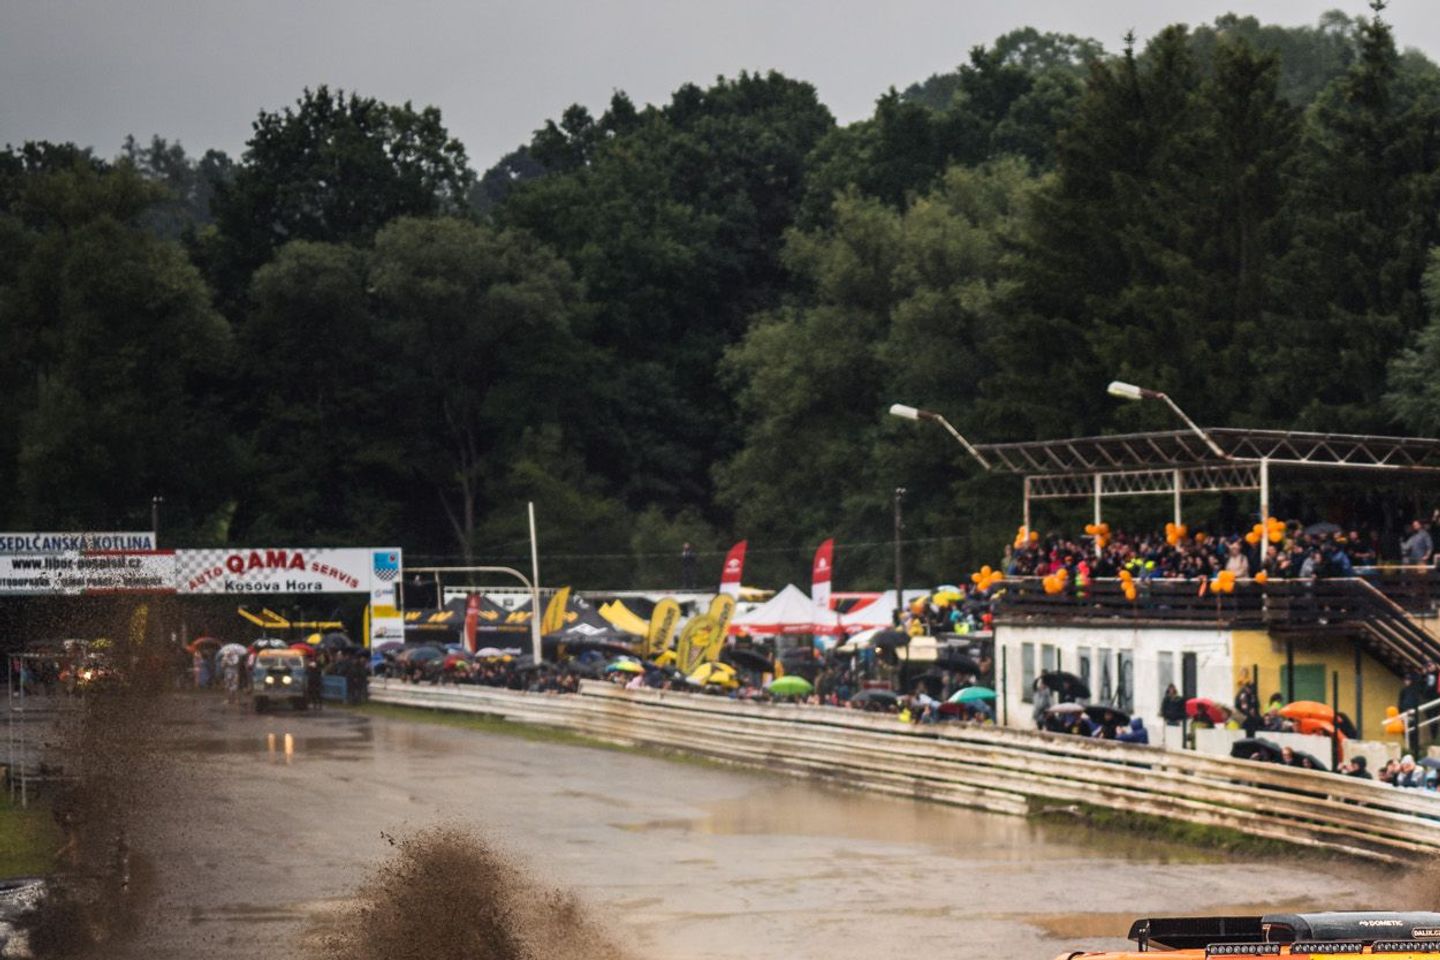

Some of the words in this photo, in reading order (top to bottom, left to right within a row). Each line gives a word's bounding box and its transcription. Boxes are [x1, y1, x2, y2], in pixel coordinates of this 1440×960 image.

[91, 535, 151, 550] KOTLINA
[226, 550, 306, 573] QAMA
[188, 566, 223, 591] AUTO
[224, 580, 280, 592] Kosova
[286, 578, 323, 591] Hora
[311, 562, 360, 589] SERVIS
[1369, 919, 1403, 927] DOMETIC
